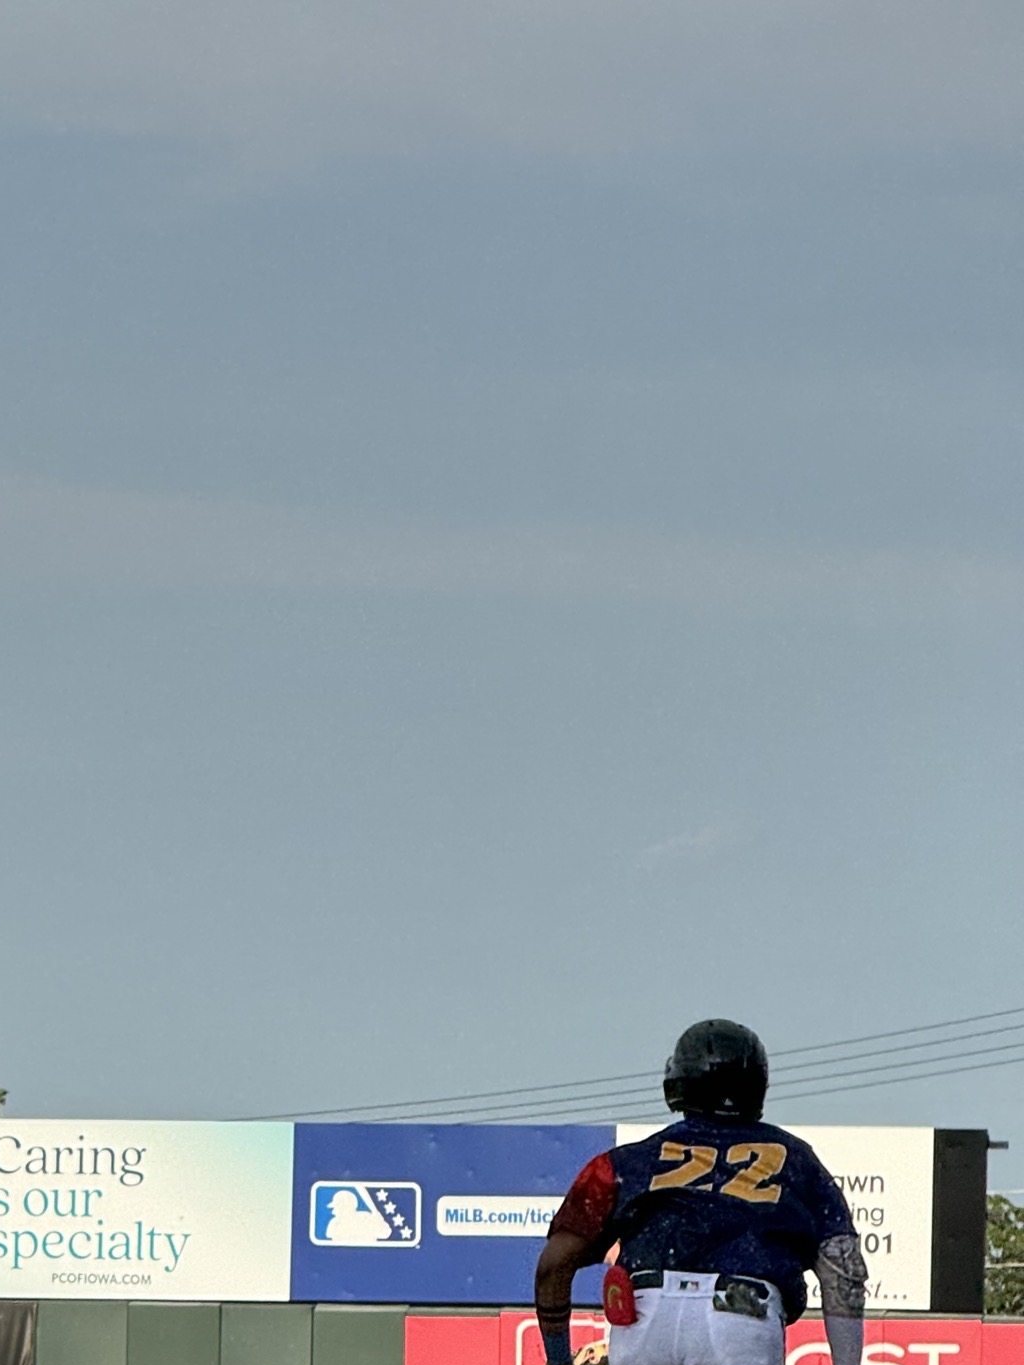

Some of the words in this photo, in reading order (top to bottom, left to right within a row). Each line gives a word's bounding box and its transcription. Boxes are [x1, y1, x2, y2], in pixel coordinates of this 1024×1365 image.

[649, 1141, 788, 1204] 22
[23, 1186, 103, 1218] our
[444, 1208, 556, 1227] MiLB.com/tic
[856, 1231, 893, 1254] 01
[51, 1272, 152, 1285] PCOFIOWA.COM
